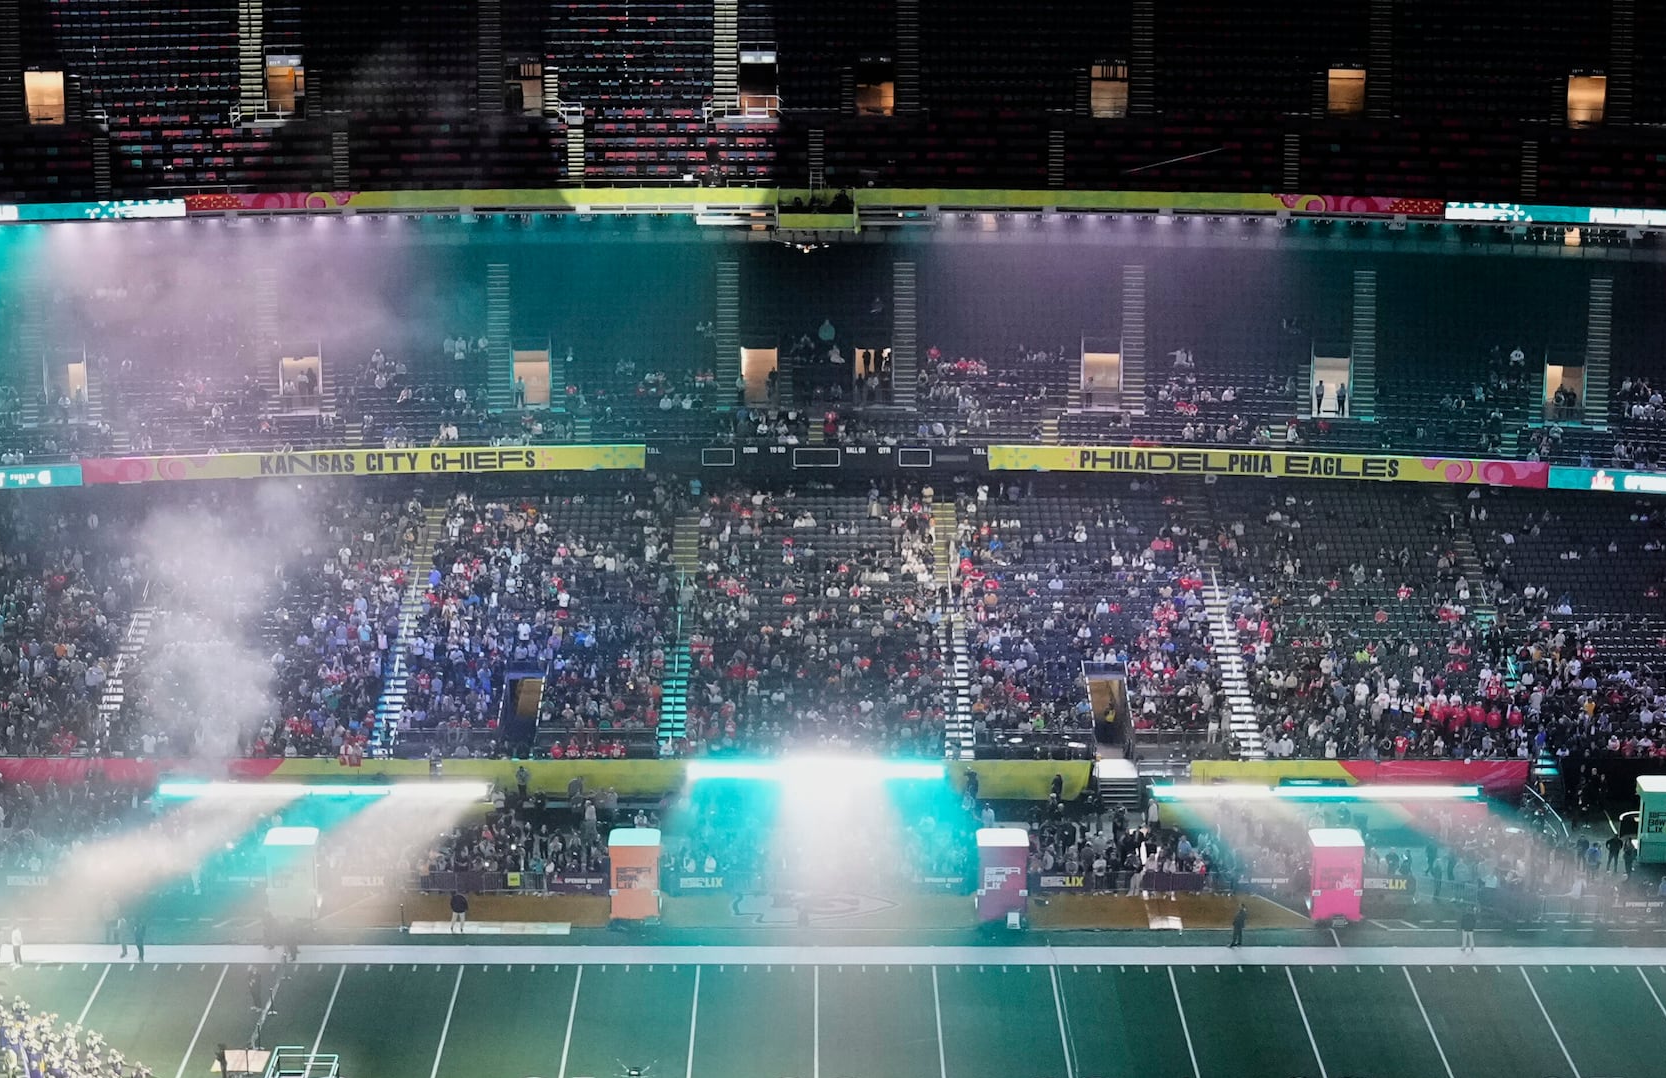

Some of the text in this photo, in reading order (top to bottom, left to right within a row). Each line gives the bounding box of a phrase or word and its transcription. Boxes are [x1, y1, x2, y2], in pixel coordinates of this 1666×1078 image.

[260, 450, 535, 475] KANSAS CITY CHIEFS
[1080, 451, 1398, 477] PHILADELPHIA EAGLES
[704, 877, 723, 888] LIX
[1064, 877, 1084, 887] LIX
[1388, 879, 1407, 890] LIX
